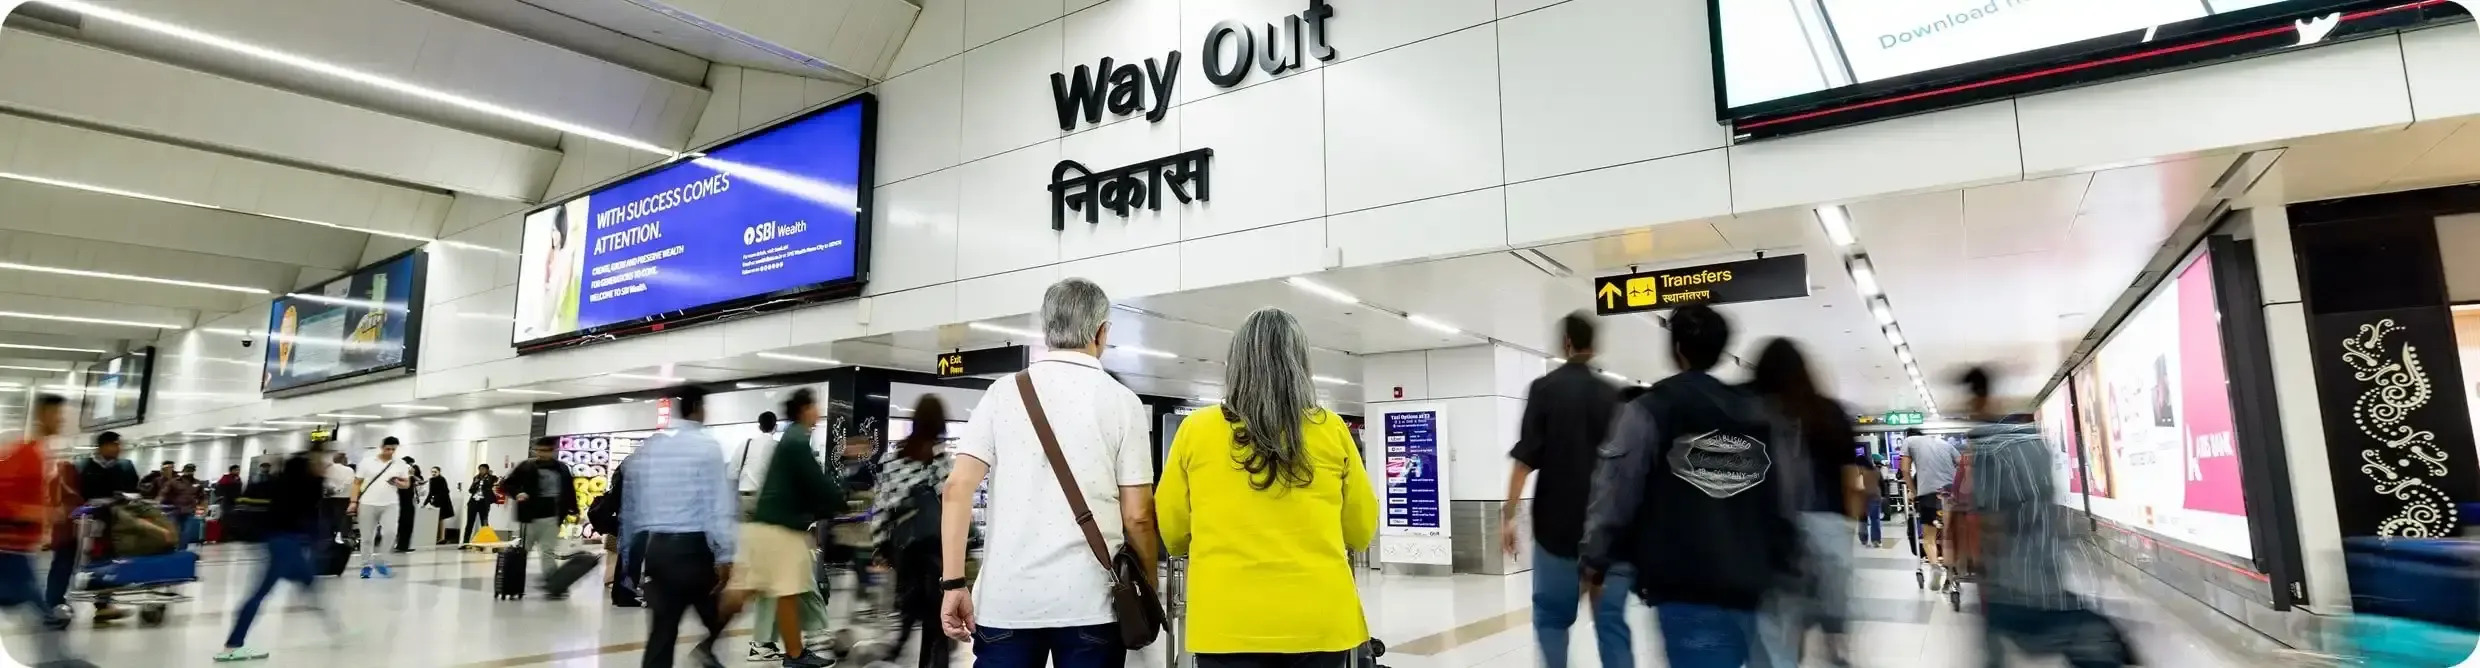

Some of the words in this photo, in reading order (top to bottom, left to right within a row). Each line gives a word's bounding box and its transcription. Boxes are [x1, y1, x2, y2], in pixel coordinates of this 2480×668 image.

[1878, 0, 1999, 50] Download
[1050, 50, 1181, 131] Way
[1202, 0, 1336, 88] Out
[597, 205, 625, 230] WITH
[626, 187, 681, 221] SUCCESS
[683, 171, 730, 204] COMES
[1047, 147, 1213, 231] निकास
[593, 221, 662, 256] ATTENTION.
[755, 220, 776, 243] SBI
[777, 220, 807, 238] Wealth
[1660, 270, 1732, 288] Transfers
[950, 355, 962, 364] Exit
